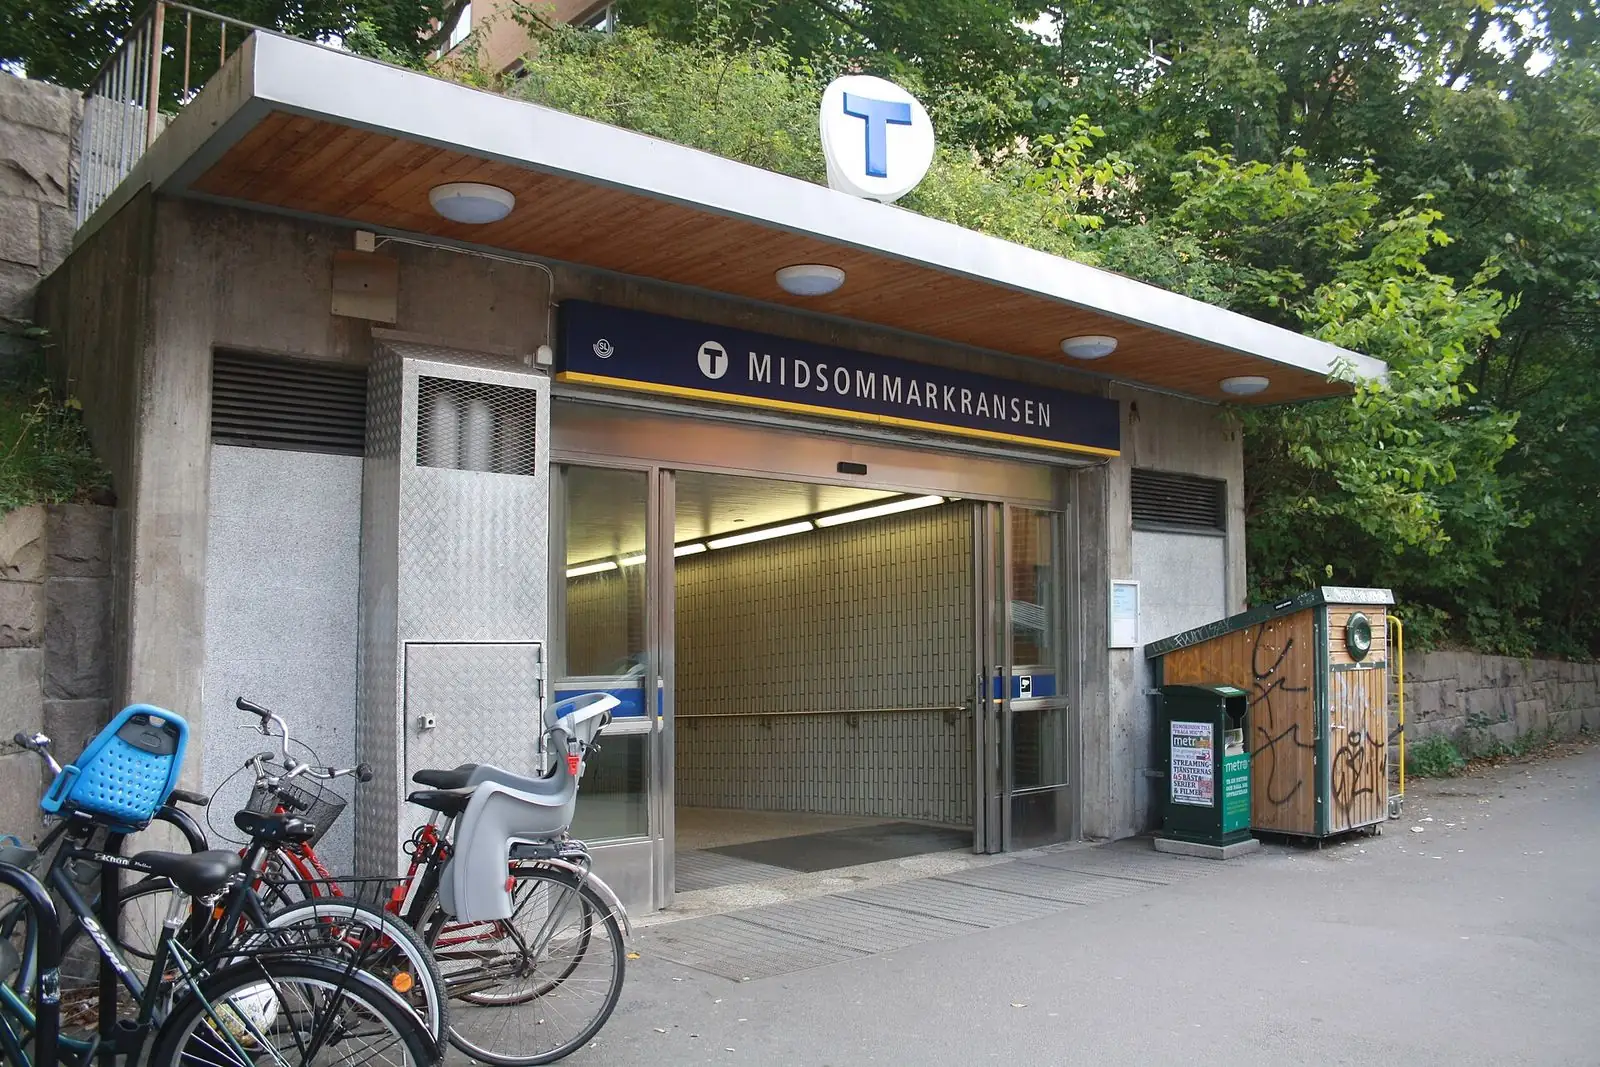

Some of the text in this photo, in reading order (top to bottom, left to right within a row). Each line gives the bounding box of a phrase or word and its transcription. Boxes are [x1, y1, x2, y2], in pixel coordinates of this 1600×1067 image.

[843, 91, 912, 178] T
[704, 348, 722, 374] T
[749, 352, 1050, 427] MIDSOMMARKRANSEN
[1225, 760, 1248, 772] metro
[1173, 780, 1196, 788] SERIER
[1180, 788, 1203, 796] FILMER
[81, 916, 129, 973] Giant
